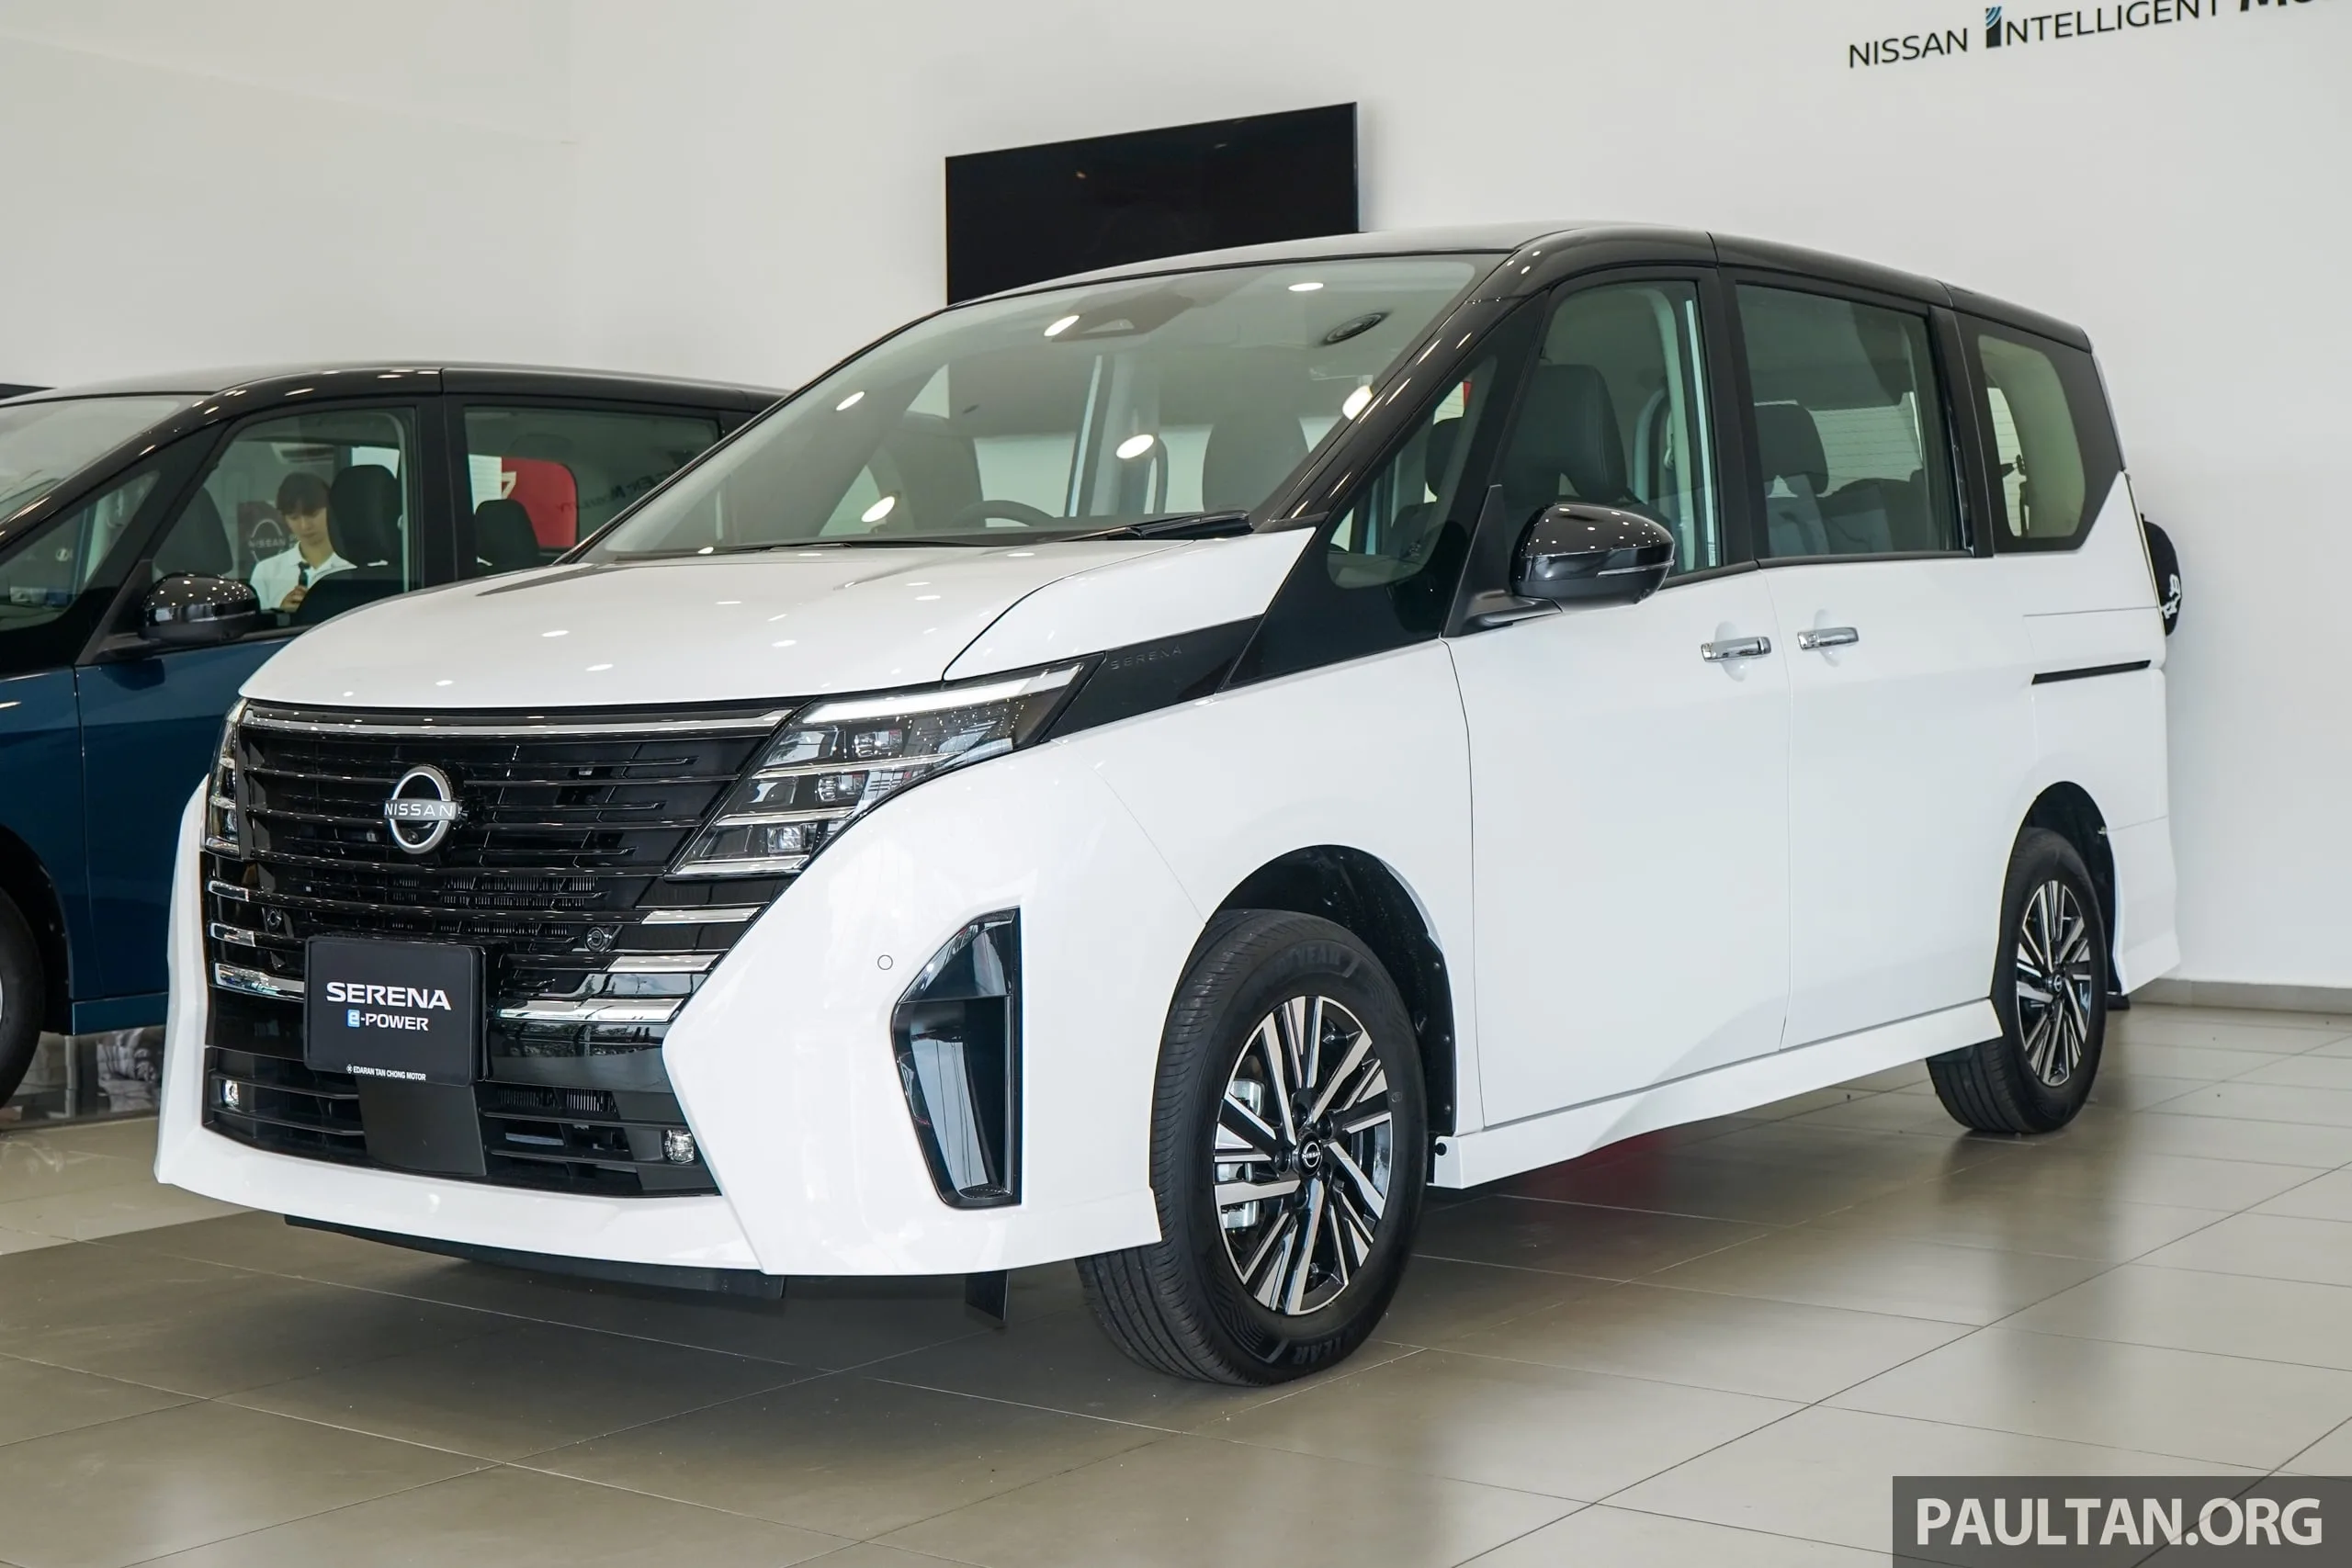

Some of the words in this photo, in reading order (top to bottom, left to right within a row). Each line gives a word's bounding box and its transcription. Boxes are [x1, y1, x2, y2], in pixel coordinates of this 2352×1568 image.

[1848, 28, 1968, 69] NISSAN
[1110, 644, 1182, 671] SERENA
[384, 803, 453, 817] NISSAN
[326, 981, 452, 1010] SERENA
[346, 1009, 429, 1032] e-POWER
[353, 1066, 375, 1076] EDARAN
[374, 1068, 386, 1077] TAN
[386, 1070, 406, 1079] CHONG
[406, 1072, 426, 1081] MOTOR
